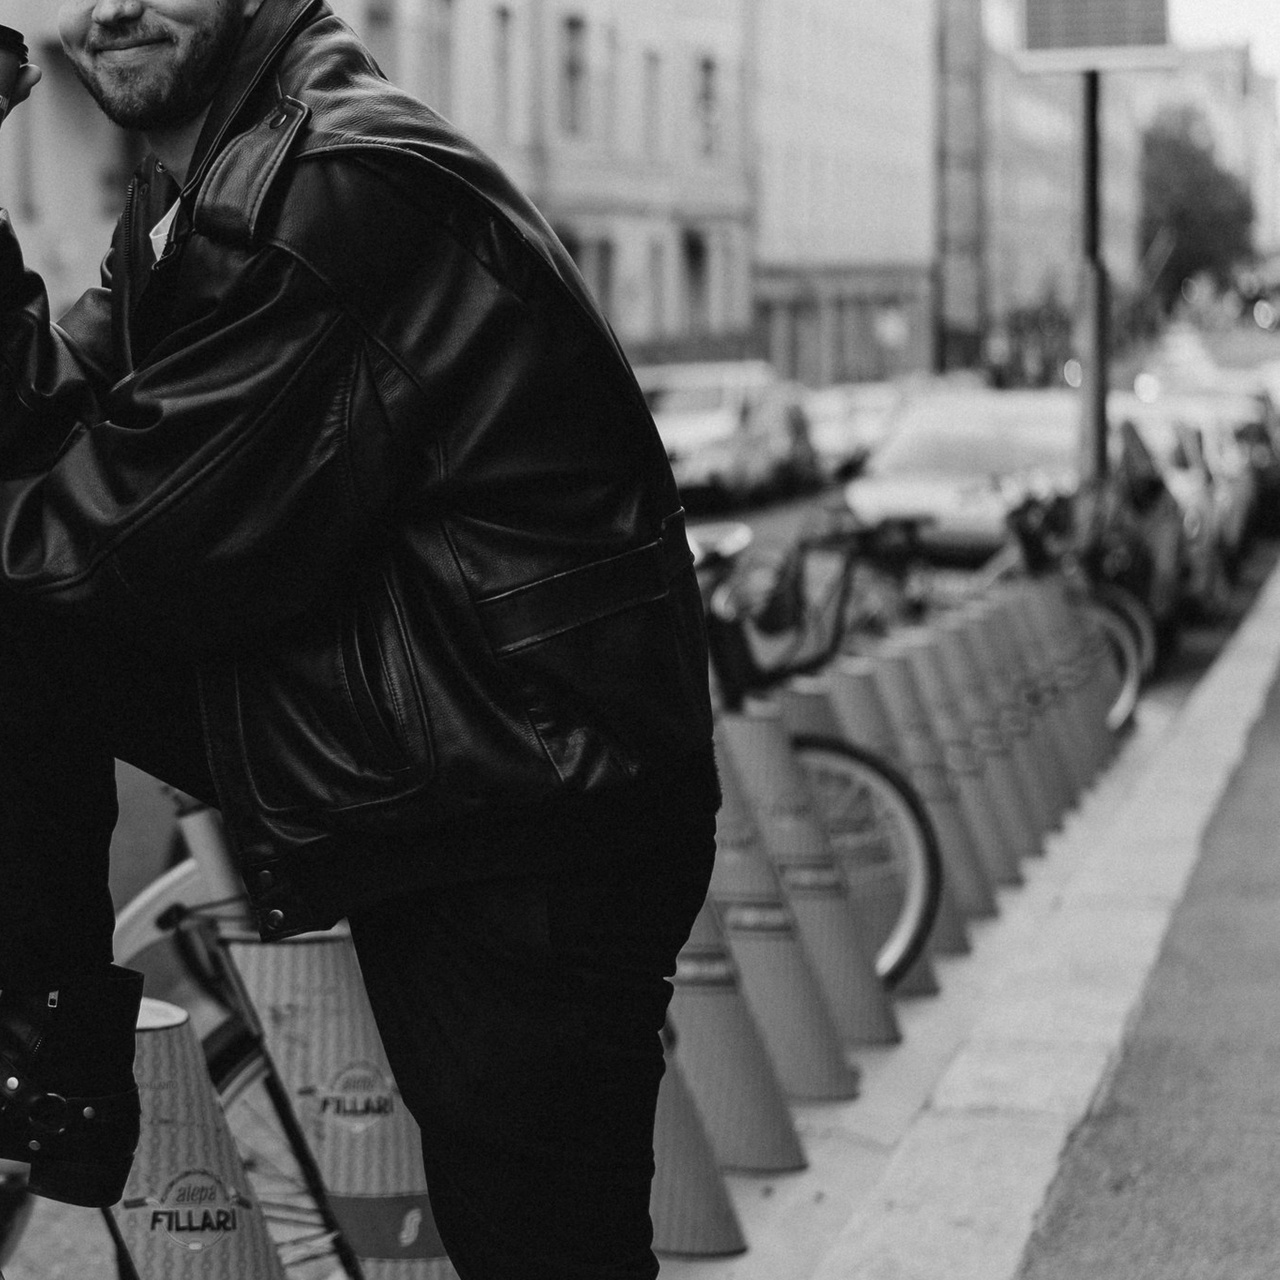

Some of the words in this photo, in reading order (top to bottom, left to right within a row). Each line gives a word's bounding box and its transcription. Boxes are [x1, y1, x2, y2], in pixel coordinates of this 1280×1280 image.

[320, 1095, 395, 1116] FILLARI
[175, 1182, 218, 1205] alepa
[150, 1207, 238, 1232] FILLARI
